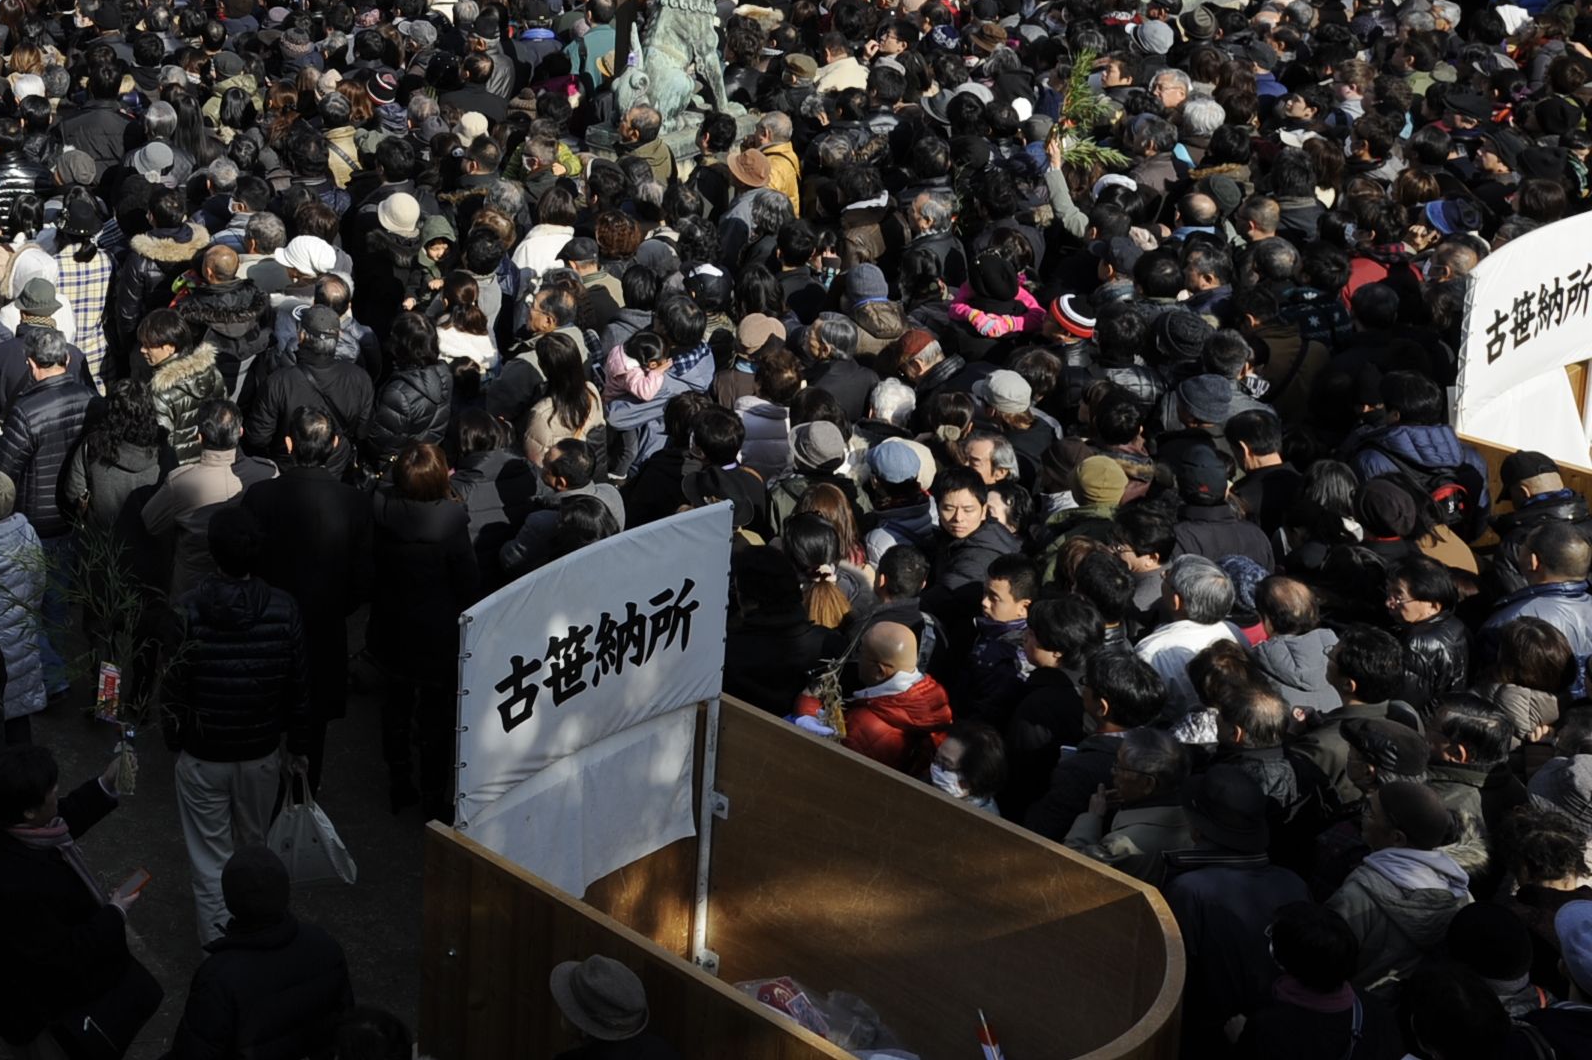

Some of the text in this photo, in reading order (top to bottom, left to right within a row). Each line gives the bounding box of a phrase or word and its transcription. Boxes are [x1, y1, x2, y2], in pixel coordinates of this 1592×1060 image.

[1485, 262, 1592, 366] 古笹納所
[493, 577, 701, 734] 古笹納所
